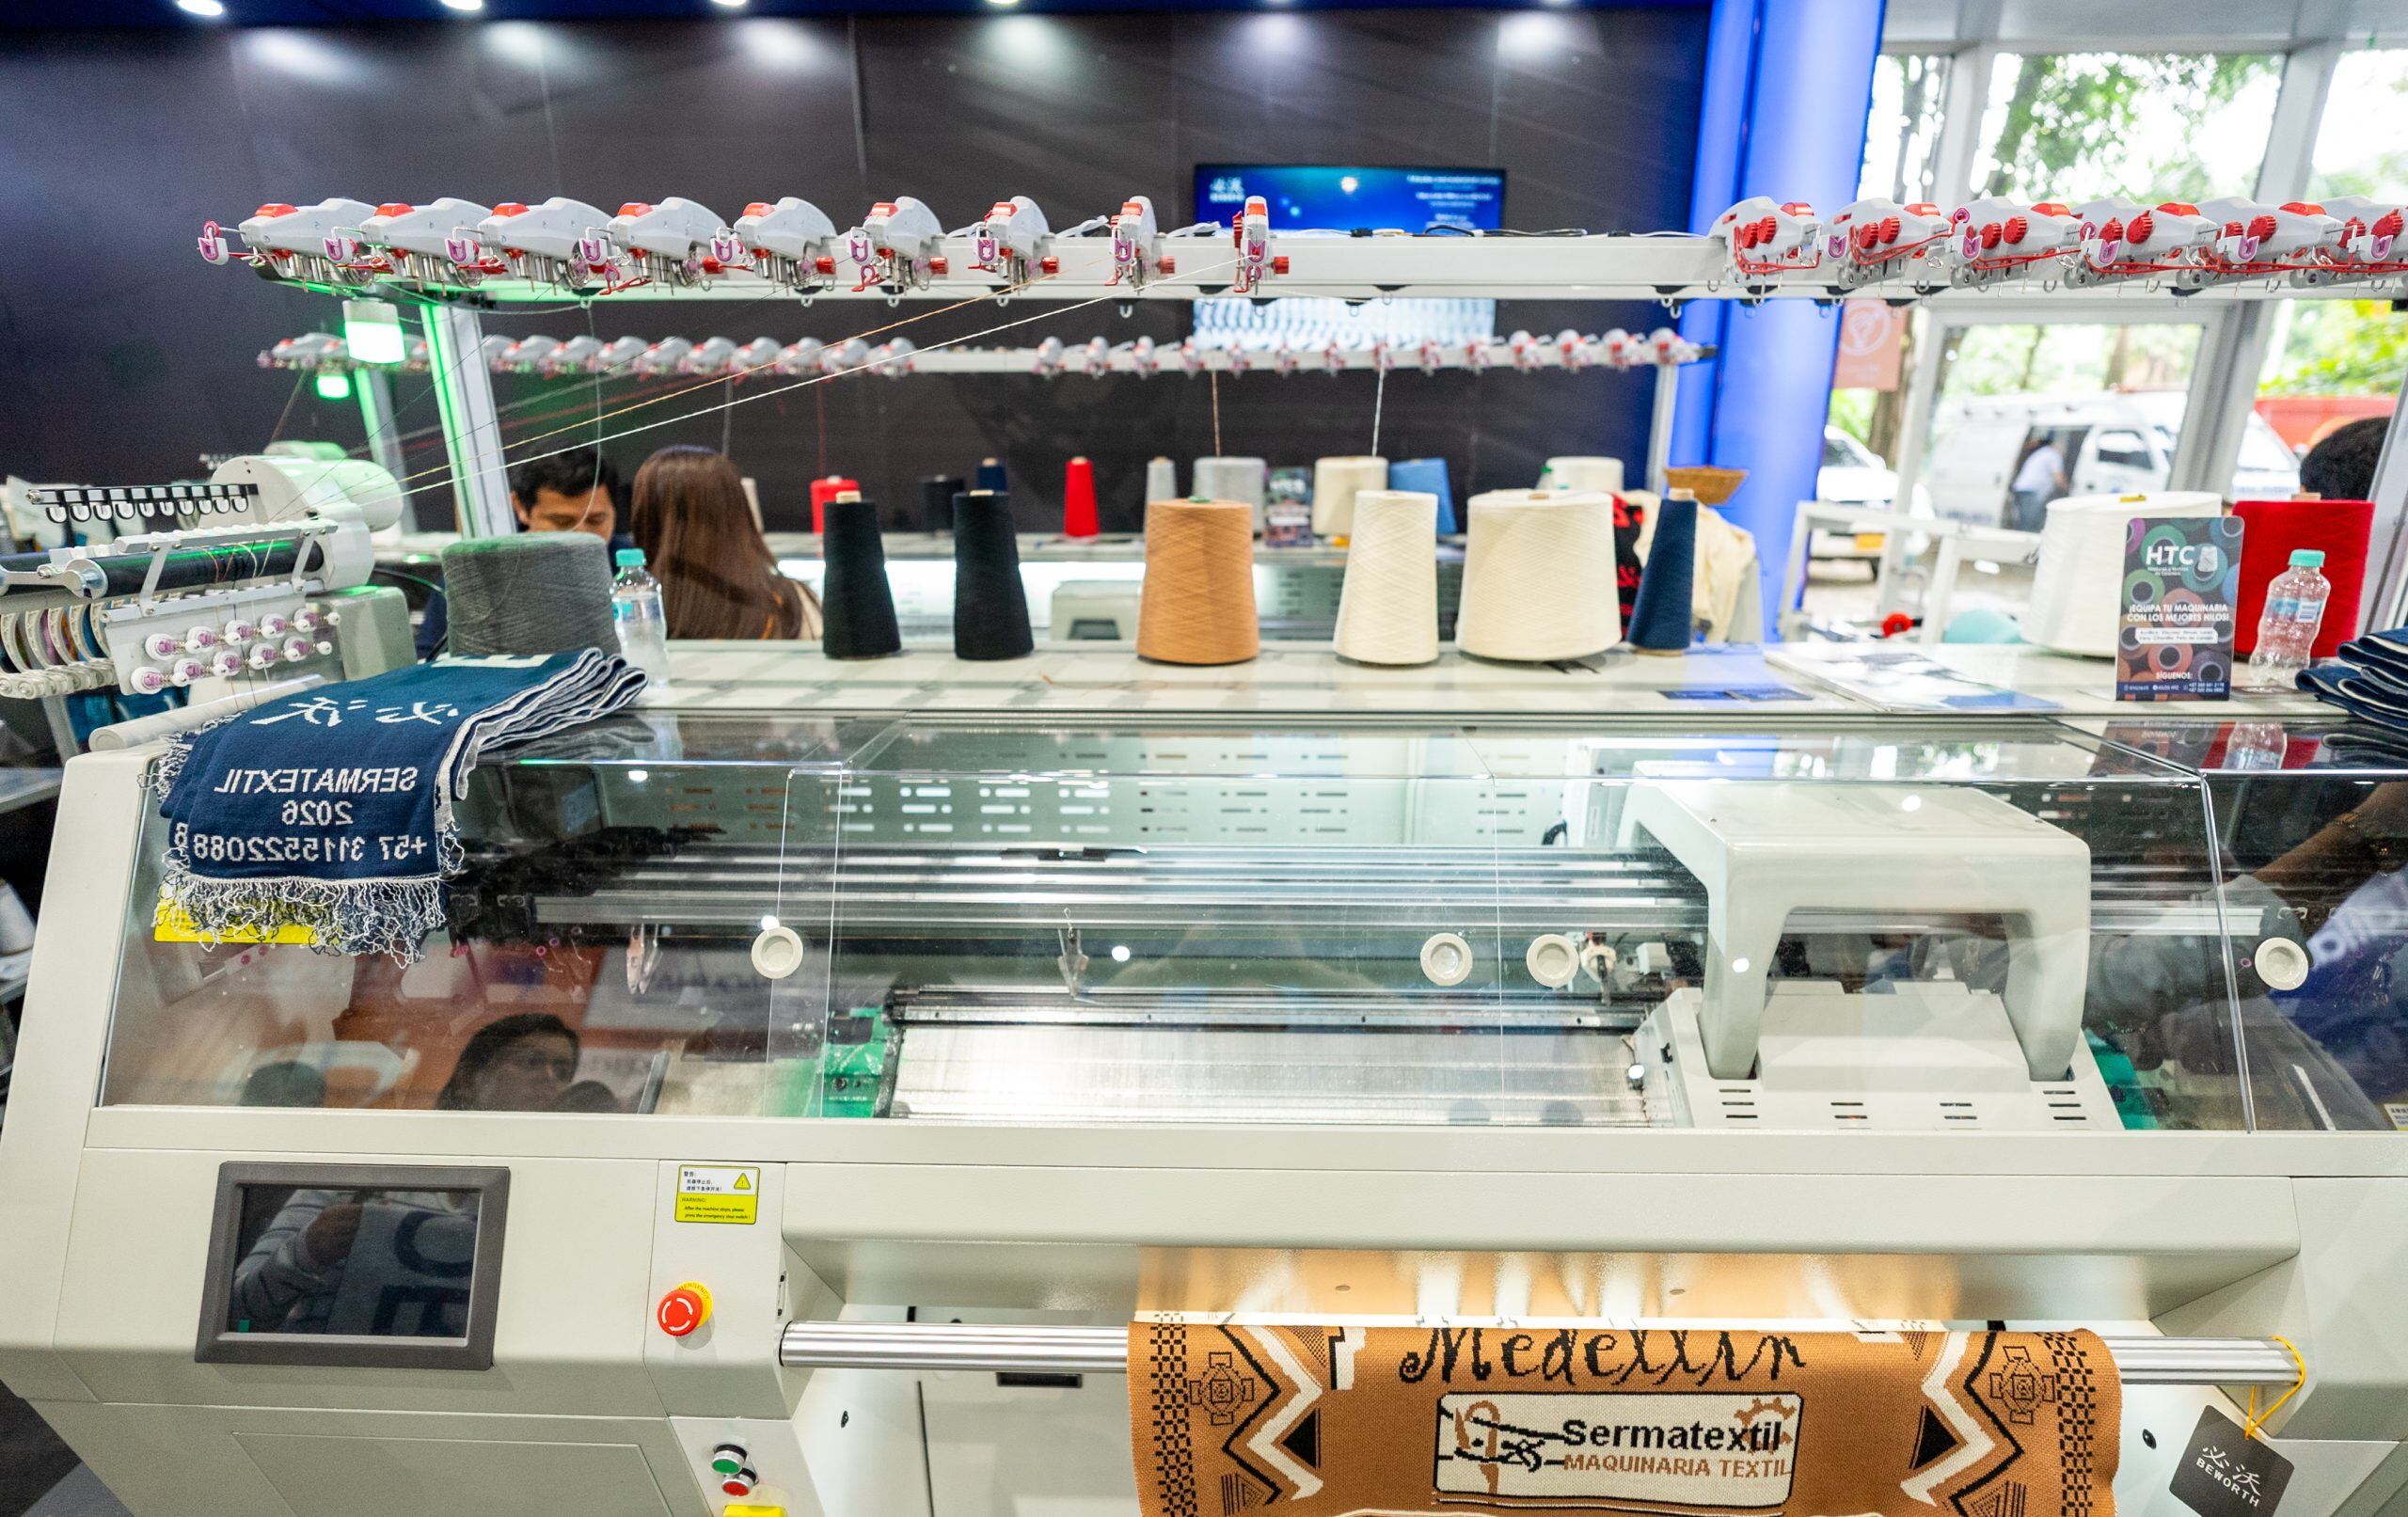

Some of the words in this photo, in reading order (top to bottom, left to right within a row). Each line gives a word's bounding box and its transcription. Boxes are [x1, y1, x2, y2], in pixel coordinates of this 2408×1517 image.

[2146, 545, 2195, 565] HTC
[2127, 613, 2147, 622] CON
[2149, 613, 2164, 622] LOS
[2165, 613, 2202, 622] MEJORES
[2162, 604, 2173, 612] TU
[2174, 604, 2227, 612] MAQUINARIA
[678, 1282, 709, 1299] MERGENCY
[1562, 1418, 1781, 1452] Sermatextil
[1562, 1454, 1710, 1477] MAQUINARIA
[1719, 1459, 1792, 1478] TEXTIL
[2202, 1446, 2261, 1497] 必沃
[2196, 1458, 2260, 1508] BEWORTH
